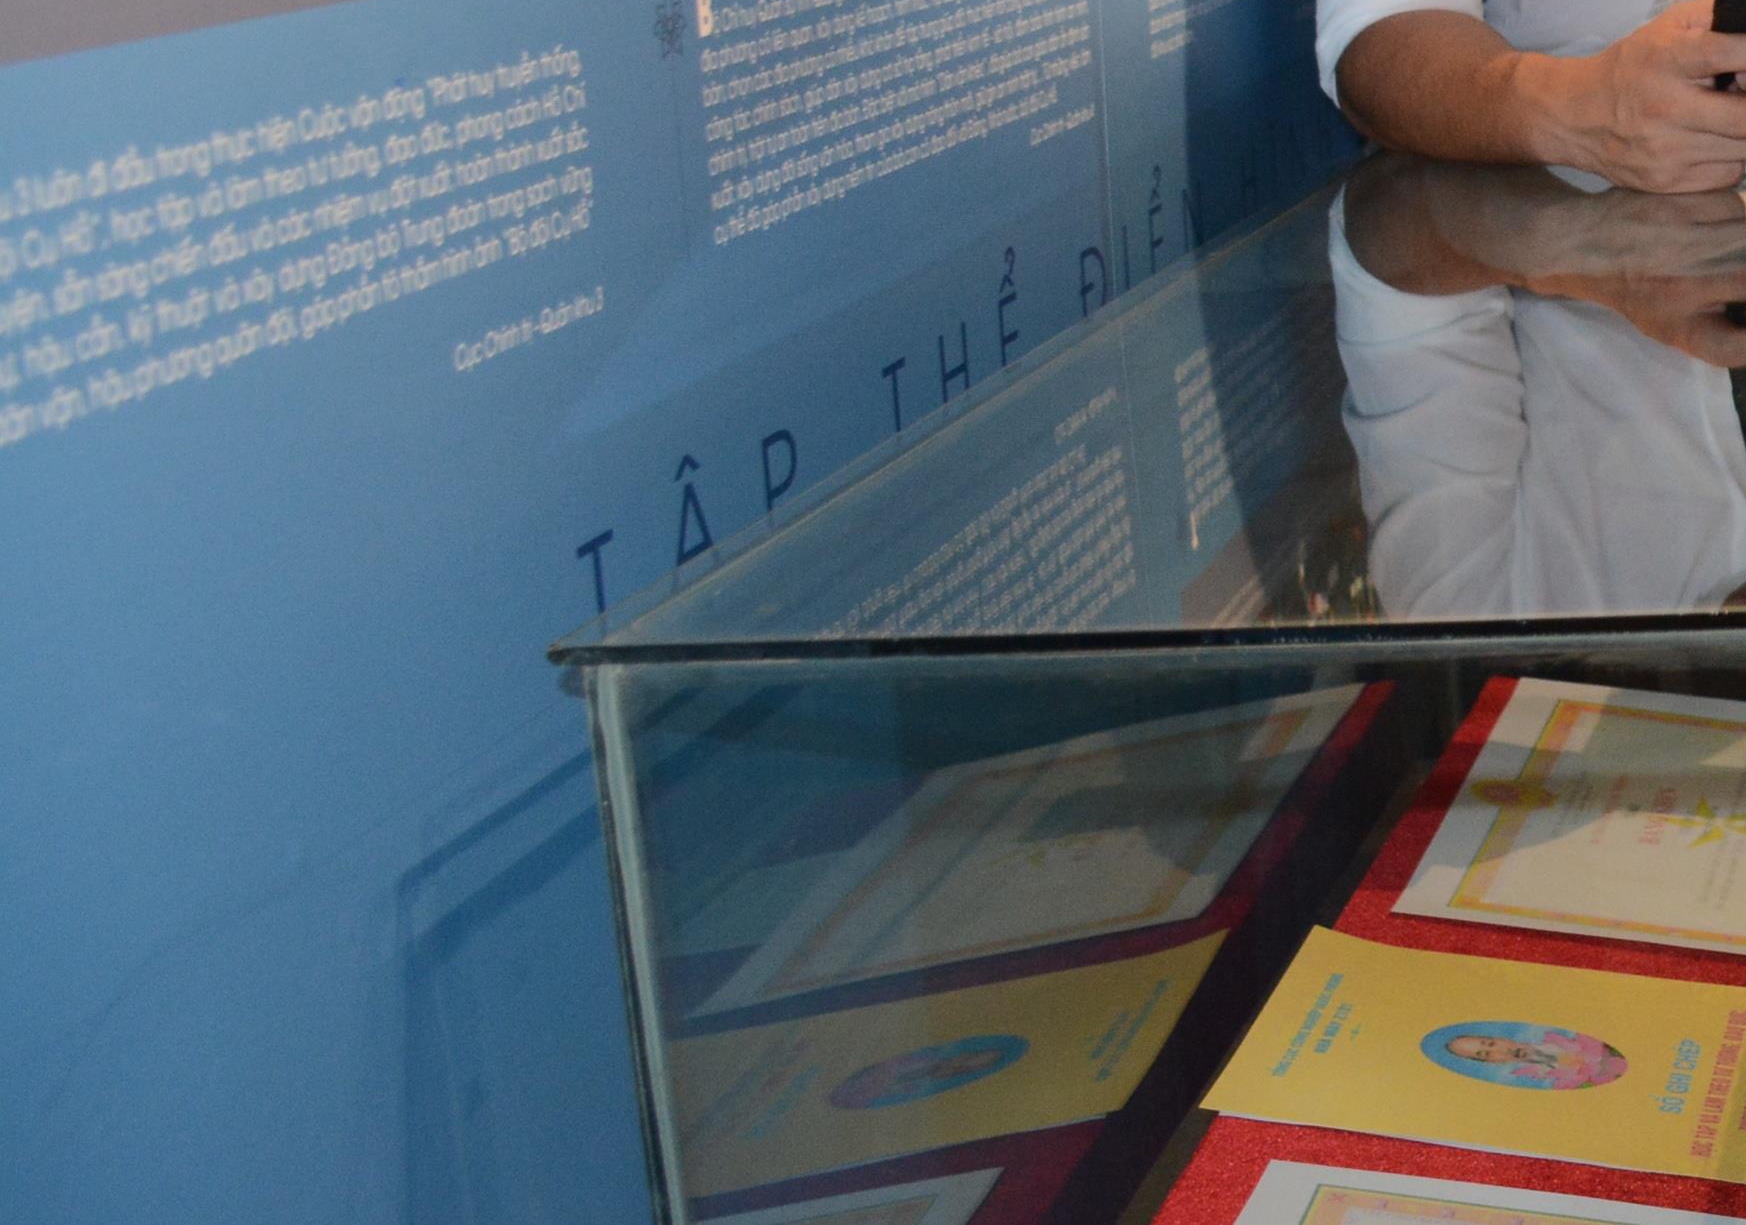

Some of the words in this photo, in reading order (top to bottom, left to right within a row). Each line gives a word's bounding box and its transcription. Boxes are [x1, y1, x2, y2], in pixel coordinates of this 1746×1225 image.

[110, 146, 155, 190] đầu
[155, 140, 210, 177] trong
[381, 87, 425, 122] động
[109, 206, 155, 243] học
[156, 192, 194, 231] tập
[196, 181, 224, 217] và
[224, 175, 261, 209] làm
[262, 165, 304, 197] theo
[383, 133, 417, 165] đạo
[455, 111, 504, 148] phong
[505, 96, 541, 129] cách
[485, 188, 525, 218] trong
[881, 246, 1019, 433] THỂ
[1079, 164, 1203, 317] ĐIỂN
[1670, 1039, 1702, 1071] CHÉP
[1664, 1073, 1692, 1094] GHI
[1707, 1077, 1732, 1096] THEO
[1648, 1094, 1685, 1115] SỔ
[1699, 1096, 1727, 1113] LÀM
[1692, 1125, 1718, 1139] TẬP
[1689, 1141, 1717, 1158] HỌC
